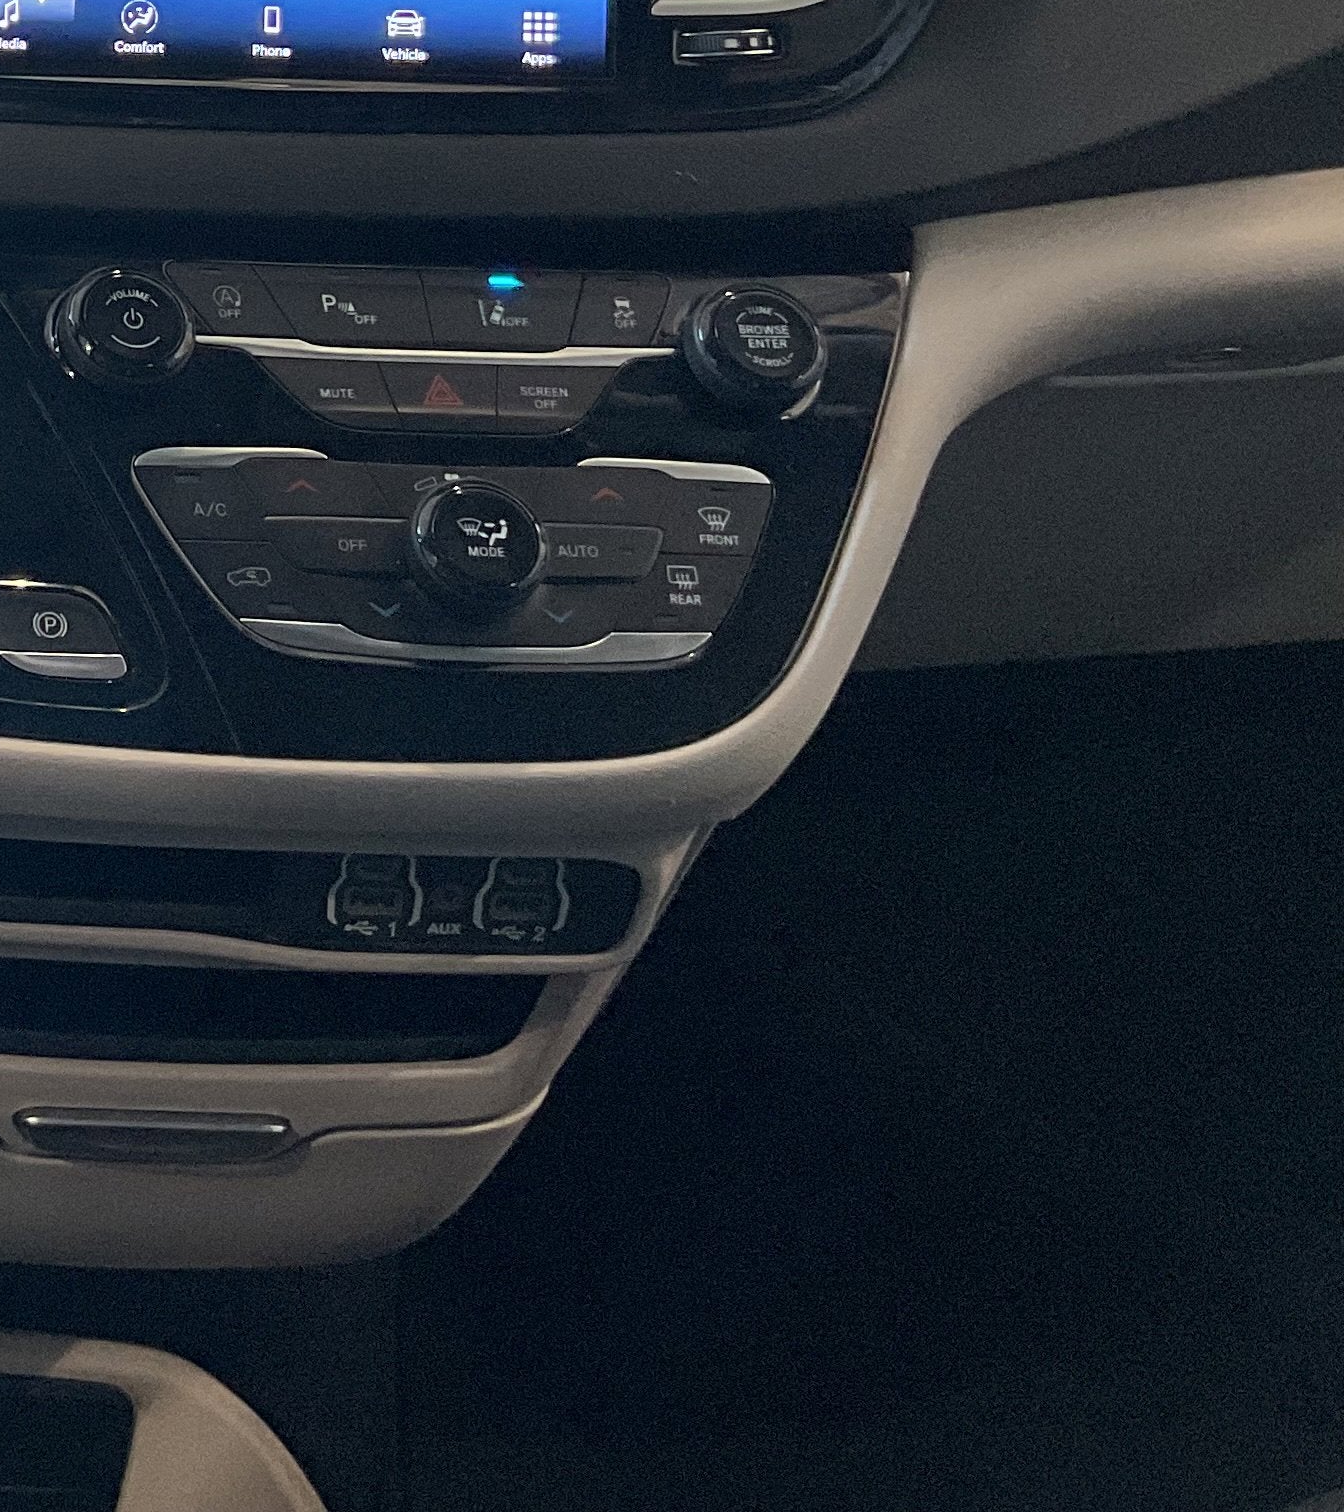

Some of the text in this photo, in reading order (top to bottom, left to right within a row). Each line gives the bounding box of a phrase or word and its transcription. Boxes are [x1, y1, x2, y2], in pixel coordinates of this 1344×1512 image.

[113, 39, 166, 55] Comfort
[250, 42, 292, 59] Phone
[381, 46, 428, 62] Vehicle
[521, 51, 556, 68] Apps
[111, 288, 151, 303] VOLUME
[217, 308, 242, 319] OFF
[354, 314, 378, 325] OFF
[737, 323, 790, 336] BROWSE
[747, 337, 788, 349] ENTER
[319, 387, 356, 400] MUTE
[519, 386, 569, 399] SCREEN
[534, 399, 558, 410] OFF
[192, 502, 228, 518] A/C
[337, 539, 368, 553] OFF
[698, 533, 739, 547] FRONT
[467, 545, 506, 558] MODE
[557, 544, 600, 559] AUTO
[669, 592, 703, 607] REAR
[43, 616, 57, 634] P
